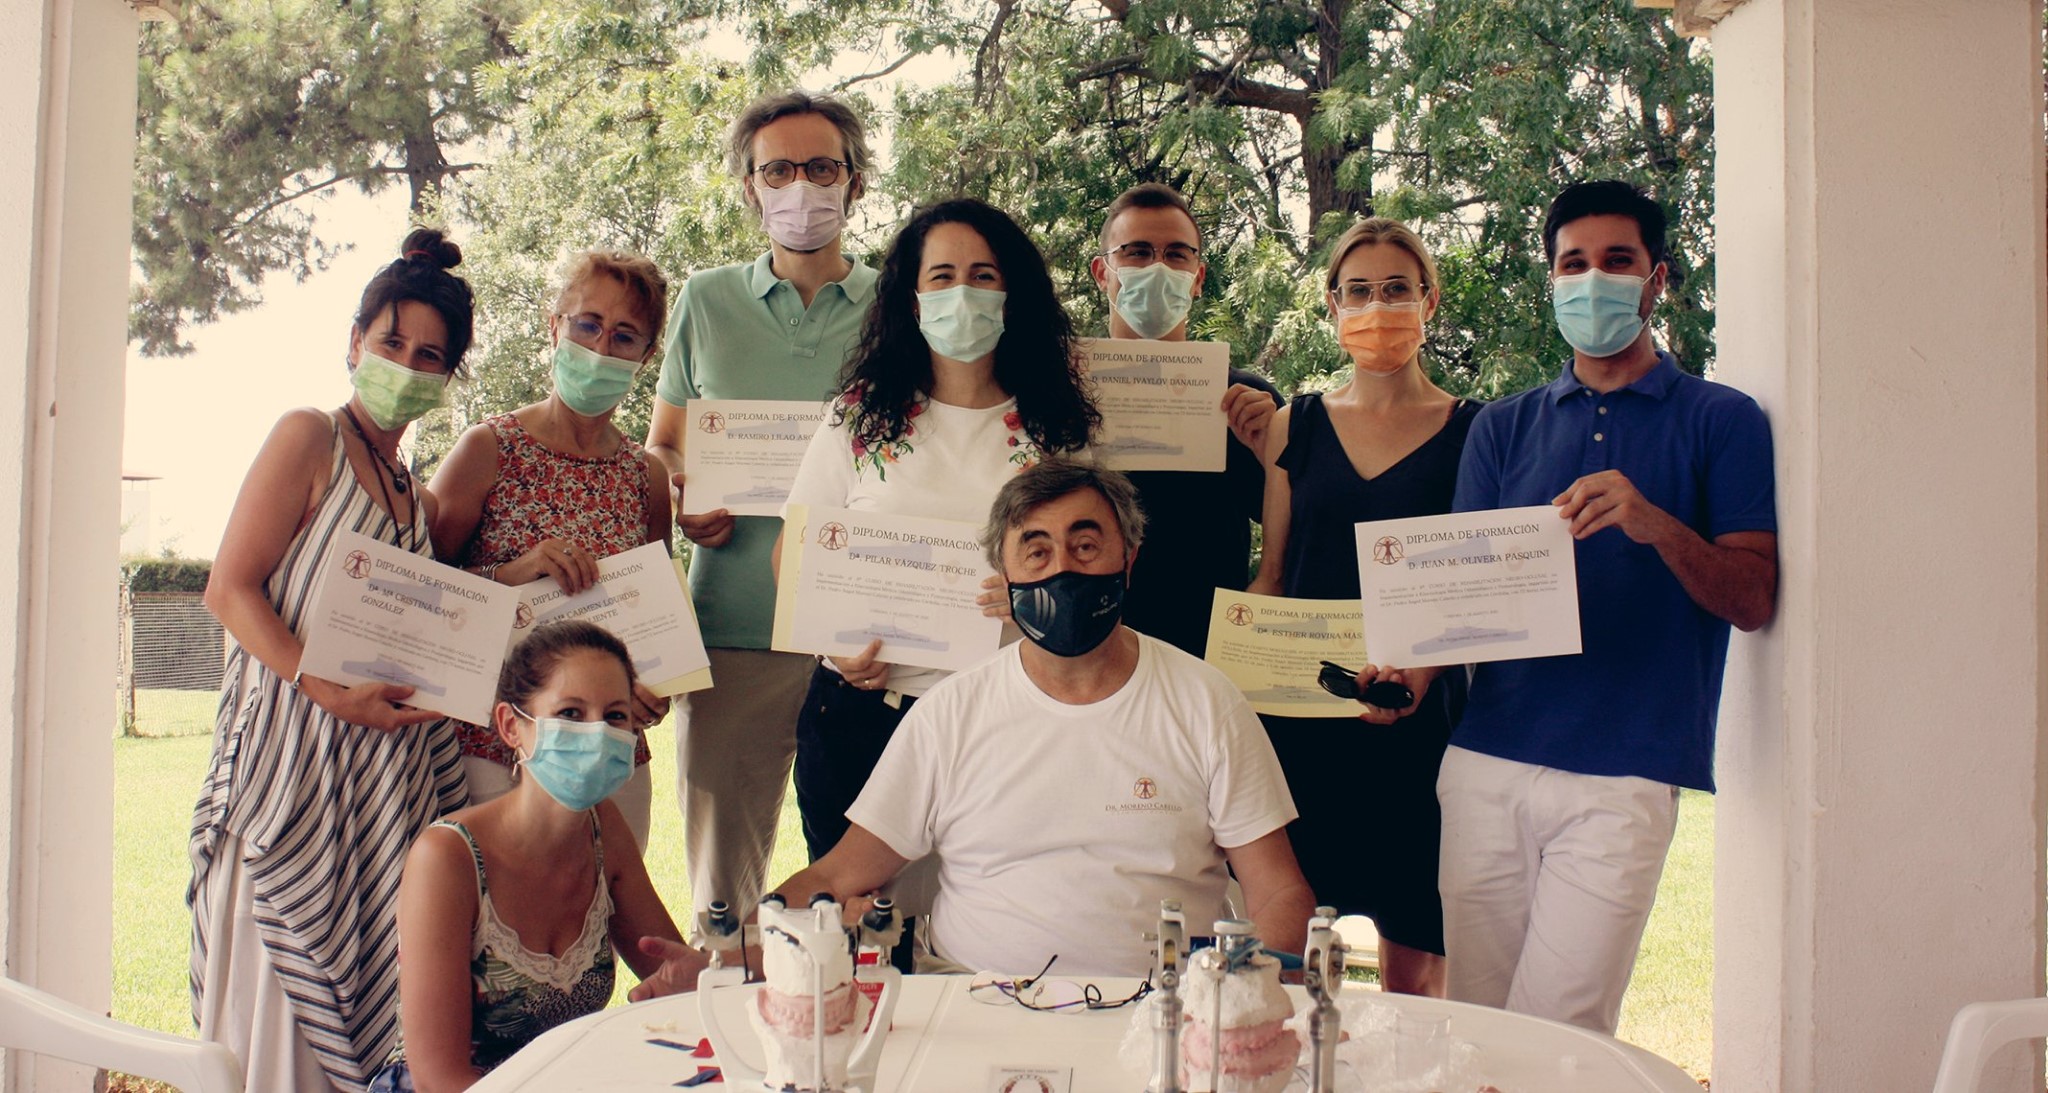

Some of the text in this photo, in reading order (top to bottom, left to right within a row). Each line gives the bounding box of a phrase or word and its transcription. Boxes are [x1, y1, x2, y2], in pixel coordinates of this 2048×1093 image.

[1093, 353, 1203, 365] DIPLOMA DE FORMACIÓN
[1102, 376, 1131, 384] DANIEL
[728, 412, 824, 422] DIPLOMA DE FORMAC
[738, 433, 770, 441] RAMIRO
[853, 526, 980, 551] DIPLOMA DE FORMACIÓN
[1406, 523, 1540, 544] DIPLOMA DE FORMACIÓN
[865, 554, 891, 565] PILAR
[939, 564, 977, 577] TROCHE
[1420, 559, 1445, 569] JUAN
[1461, 554, 1503, 566] OLIVERA
[1505, 549, 1550, 561] PASQUINI
[375, 558, 489, 604] DIPLOMA DE FORMACIÓN
[531, 562, 643, 606] DIPLO ORMACIÓN
[395, 592, 433, 613] CRISTINA
[434, 606, 458, 620] CANO
[566, 602, 602, 619] CARMEN
[1260, 608, 1299, 618] DIPLOMA
[1272, 629, 1307, 639] ESTHER
[1309, 631, 1341, 640] ROVIRA
